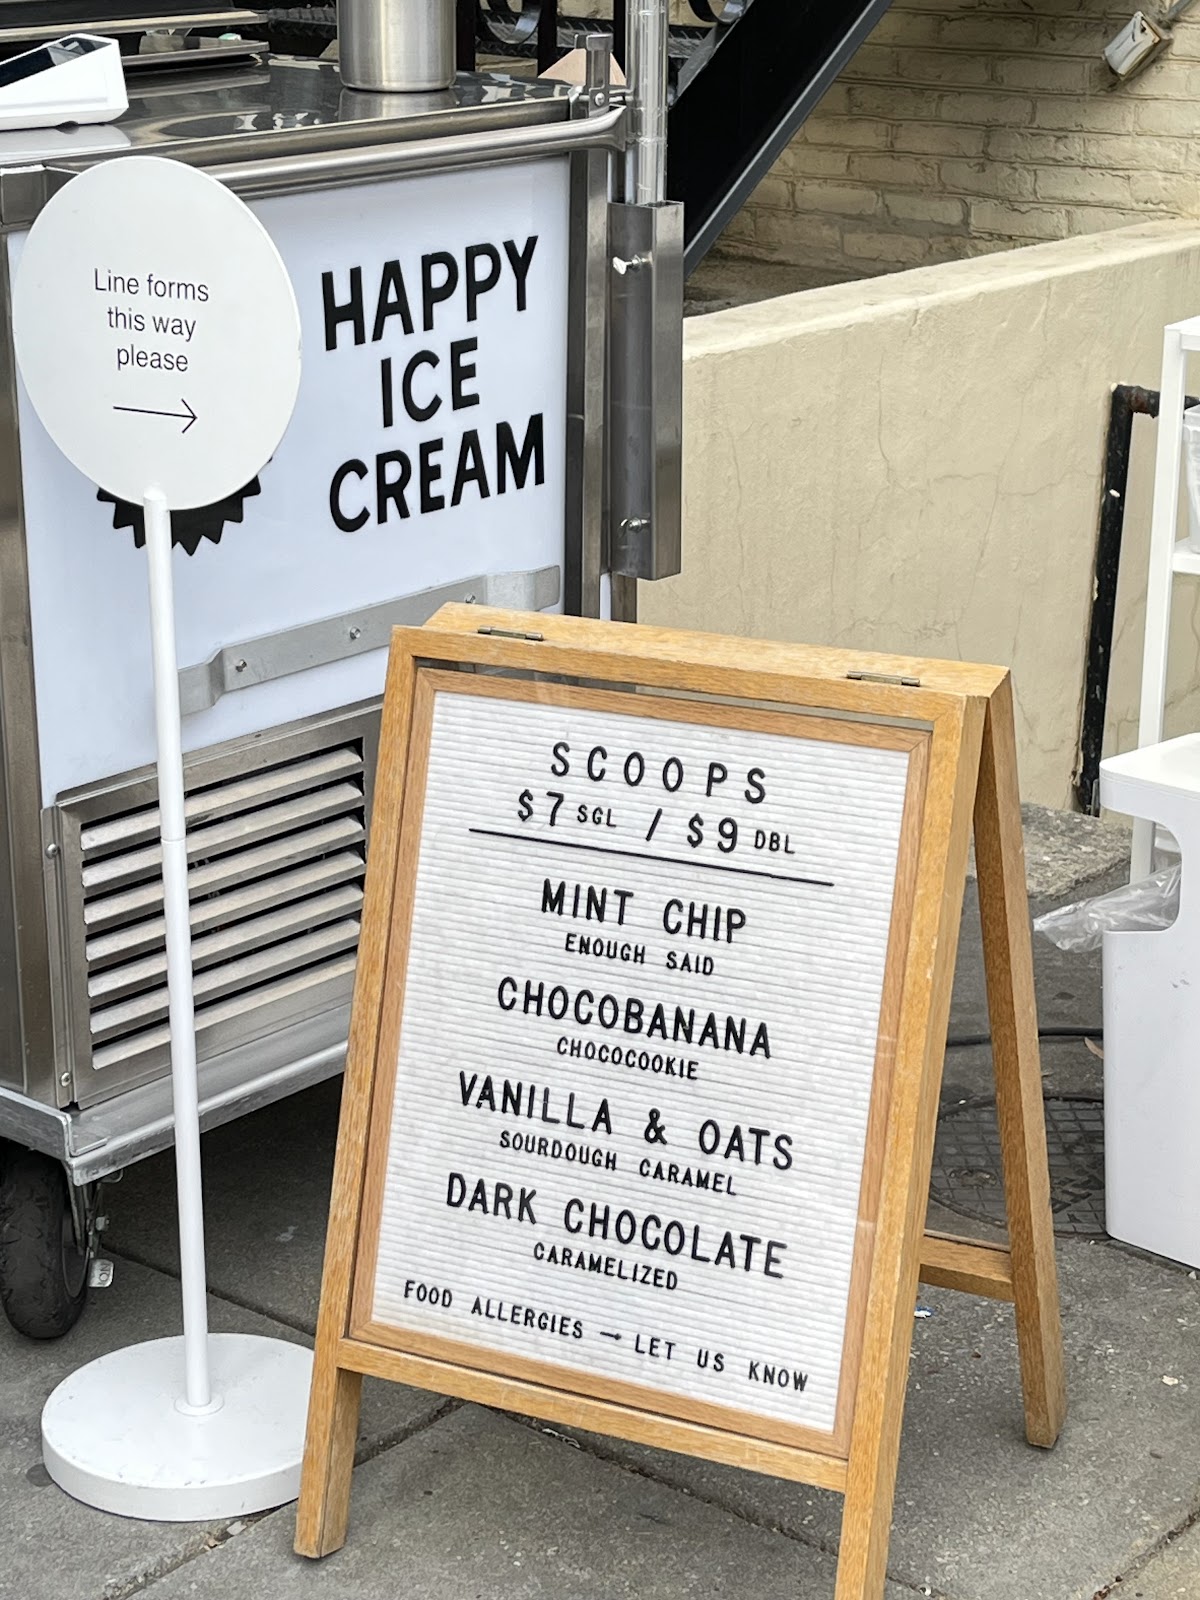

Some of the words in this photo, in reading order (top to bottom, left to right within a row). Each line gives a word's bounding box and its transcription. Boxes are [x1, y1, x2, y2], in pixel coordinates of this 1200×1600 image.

[94, 268, 139, 295] Line
[146, 273, 209, 302] forms
[321, 235, 539, 352] HAPPY
[107, 306, 145, 332] this
[152, 316, 196, 343] way
[117, 344, 188, 372] please
[380, 336, 480, 429] ICE
[329, 412, 545, 533] CREAM
[550, 741, 766, 805] SCOOPS
[576, 804, 617, 828] SGL
[644, 807, 663, 842] /
[753, 829, 796, 855] DBL
[540, 878, 634, 926] MINT
[662, 898, 746, 944] CHIP
[564, 932, 646, 965] ENOUGH
[665, 950, 715, 976] SAID
[497, 976, 772, 1059] CHOCOBANANA
[556, 1036, 699, 1081] CHOCOCOOKIE
[459, 1070, 613, 1136] VANILLA
[643, 1108, 668, 1146] &
[698, 1119, 793, 1171] OATS
[499, 1130, 618, 1172] SOURDOUGH
[639, 1158, 737, 1197] CARAMEL
[446, 1172, 538, 1225] DARK
[564, 1198, 788, 1279] CHOCOLATE
[533, 1241, 678, 1291] CARAMELIZED
[403, 1279, 453, 1308] FOOD
[470, 1296, 583, 1339] ALLERGIES
[634, 1333, 676, 1361] LET
[696, 1348, 725, 1373] US
[748, 1360, 808, 1392] KNOW
